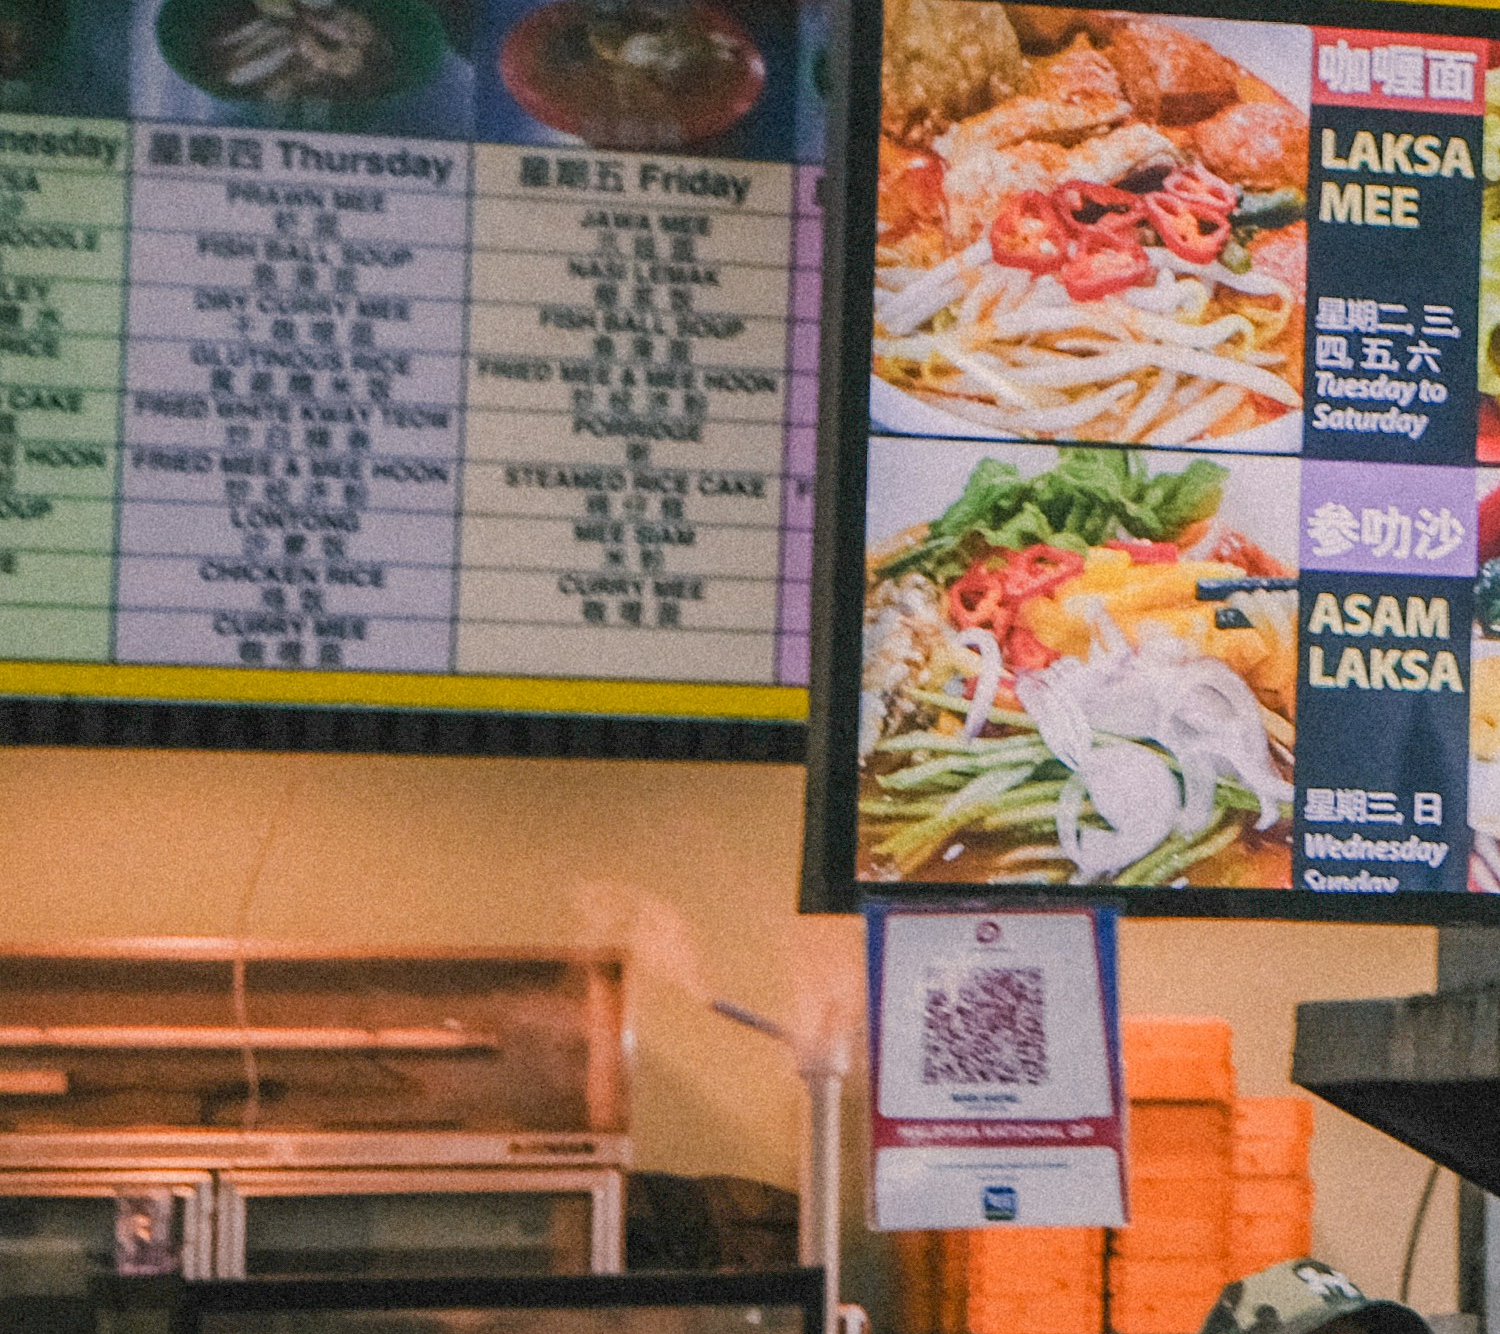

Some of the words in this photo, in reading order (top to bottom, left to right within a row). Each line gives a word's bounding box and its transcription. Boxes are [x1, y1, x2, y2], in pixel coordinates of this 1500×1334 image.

[277, 139, 454, 187] Thursday
[1320, 128, 1475, 179] LAKSA
[639, 163, 752, 205] Friday
[1319, 180, 1420, 228] MEE
[1314, 370, 1418, 407] Tuesday
[1418, 378, 1449, 403] to
[1312, 402, 1430, 440] Saturday
[1307, 501, 1466, 560] 参叻沙
[1307, 592, 1451, 640] ASAM
[1308, 645, 1465, 693] LAKSA
[1303, 831, 1449, 868] Wednesday
